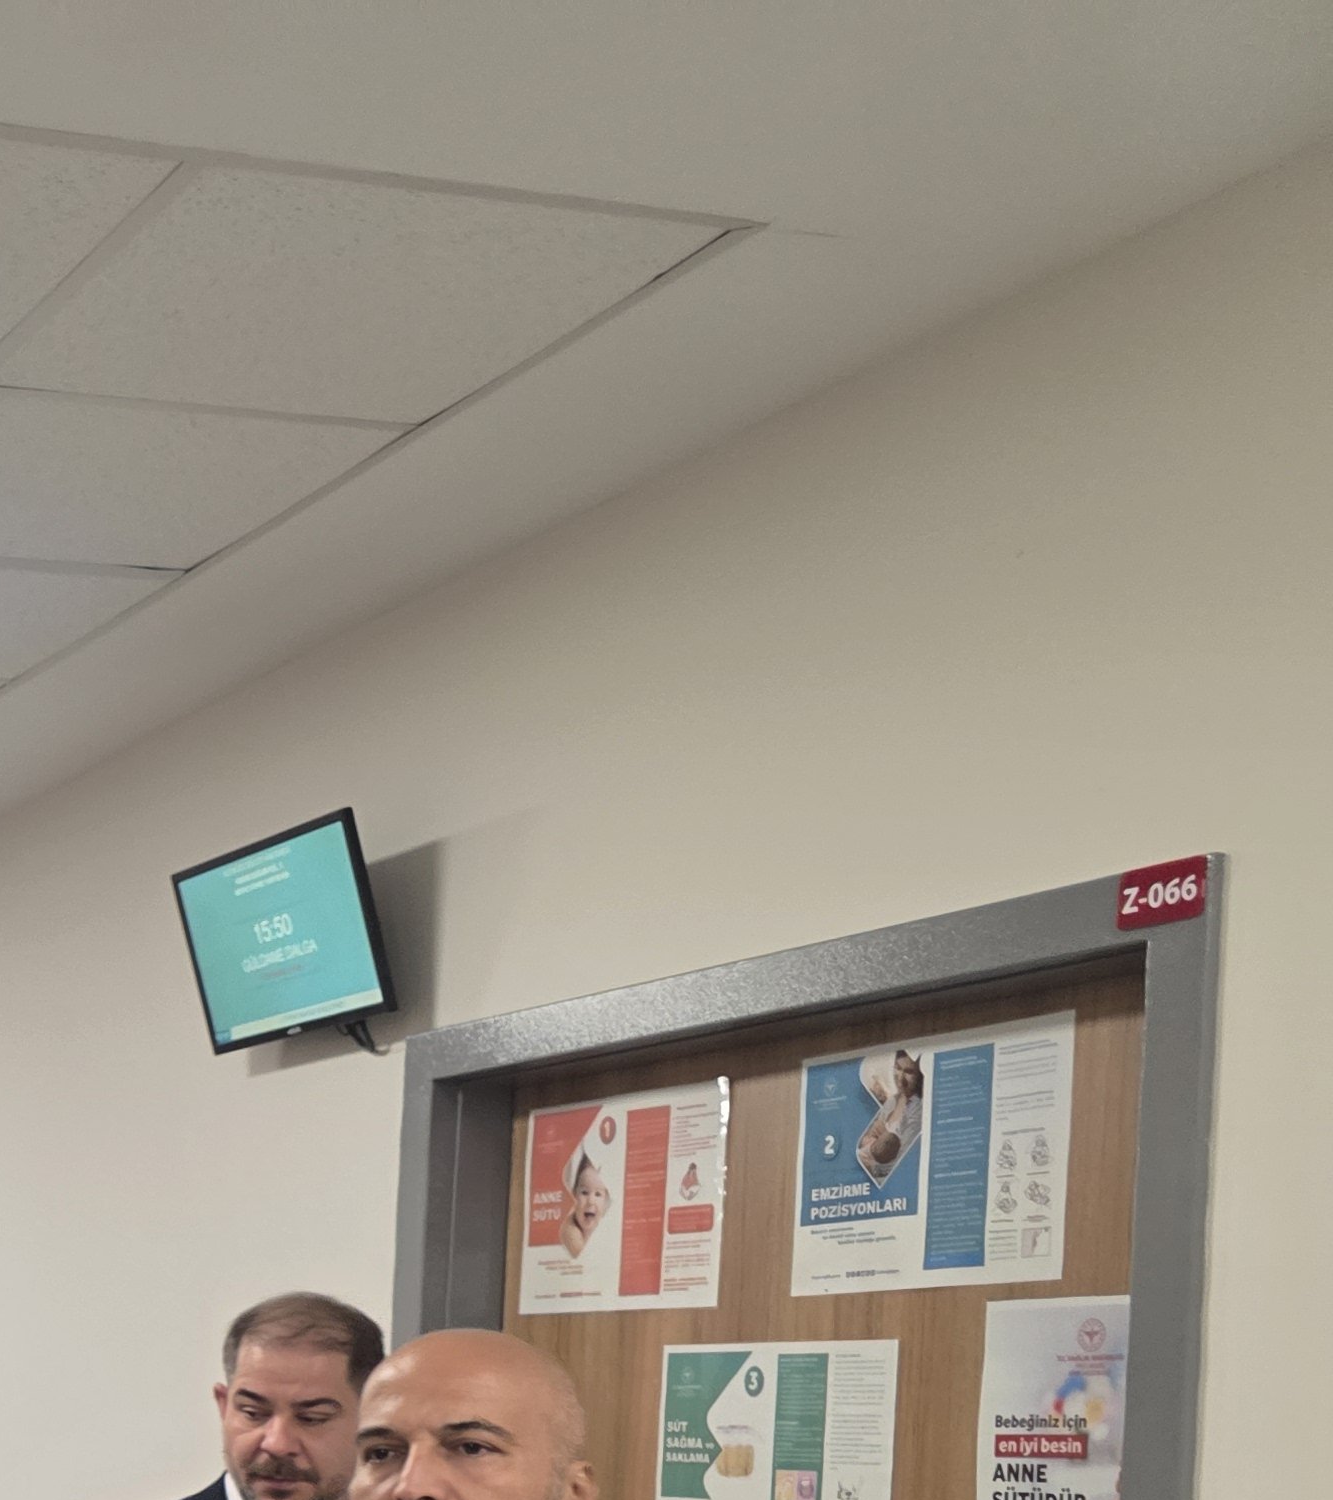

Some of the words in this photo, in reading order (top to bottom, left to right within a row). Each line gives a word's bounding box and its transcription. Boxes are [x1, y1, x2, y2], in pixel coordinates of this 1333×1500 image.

[1121, 874, 1197, 915] Z-066
[254, 913, 293, 944] 15:50
[603, 1121, 611, 1138] 1
[824, 1135, 835, 1155] 2
[533, 1190, 563, 1205] ANNE
[811, 1182, 871, 1202] EMZİRME
[810, 1197, 907, 1221] POZİSYONLARI
[748, 1372, 758, 1391] 3
[667, 1418, 689, 1432] SÜT
[994, 1414, 1059, 1432] Bebeğiniz
[1062, 1415, 1088, 1433] için
[998, 1439, 1017, 1453] en
[1019, 1437, 1038, 1456] iyi
[1042, 1437, 1083, 1454] besin
[992, 1463, 1048, 1483] ANNE
